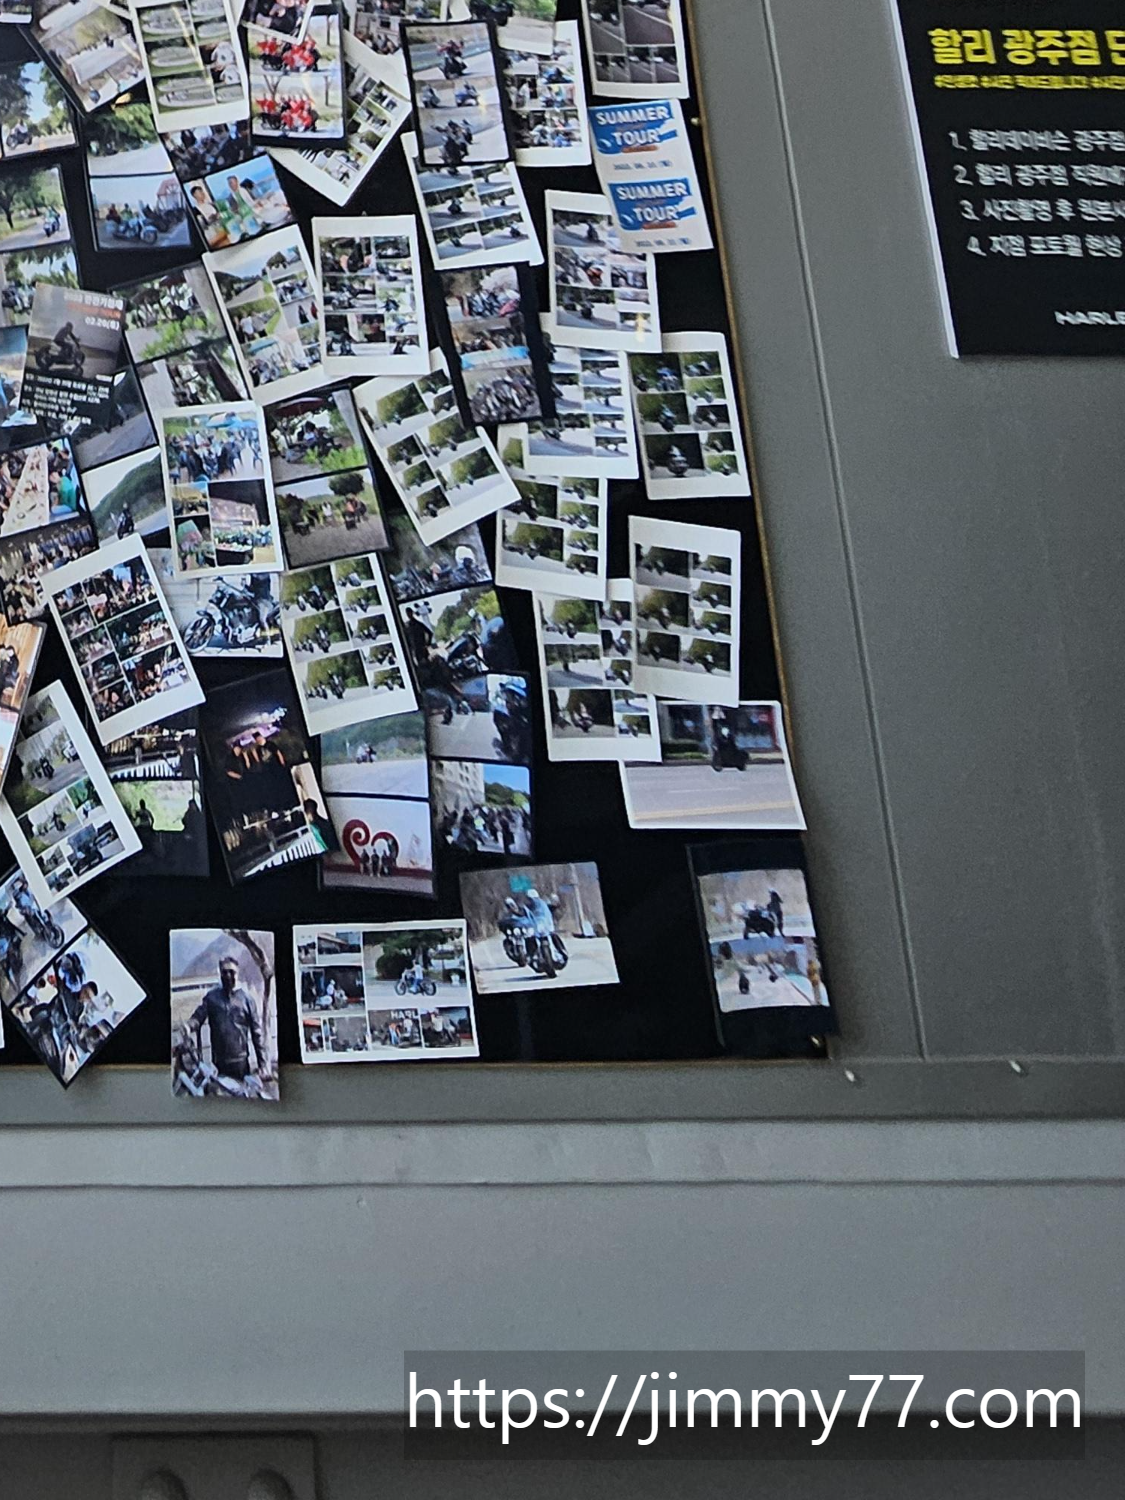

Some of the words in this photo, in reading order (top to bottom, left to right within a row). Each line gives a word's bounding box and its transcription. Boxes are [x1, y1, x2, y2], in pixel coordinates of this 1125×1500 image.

[928, 28, 996, 64] 할리
[1001, 29, 1101, 65] 광주점
[595, 106, 670, 125] SUMMER
[612, 128, 660, 145] TOUR
[969, 129, 1071, 151] 할리데이비슨
[975, 163, 1012, 186] 할리
[1015, 164, 1069, 186] 광주점
[617, 182, 688, 200] SUMMER
[633, 205, 680, 222] TOUR
[983, 199, 1053, 221] 사진촬영
[1056, 199, 1076, 221] 후
[989, 235, 1027, 257] 지점
[1029, 235, 1084, 257] 포토월
